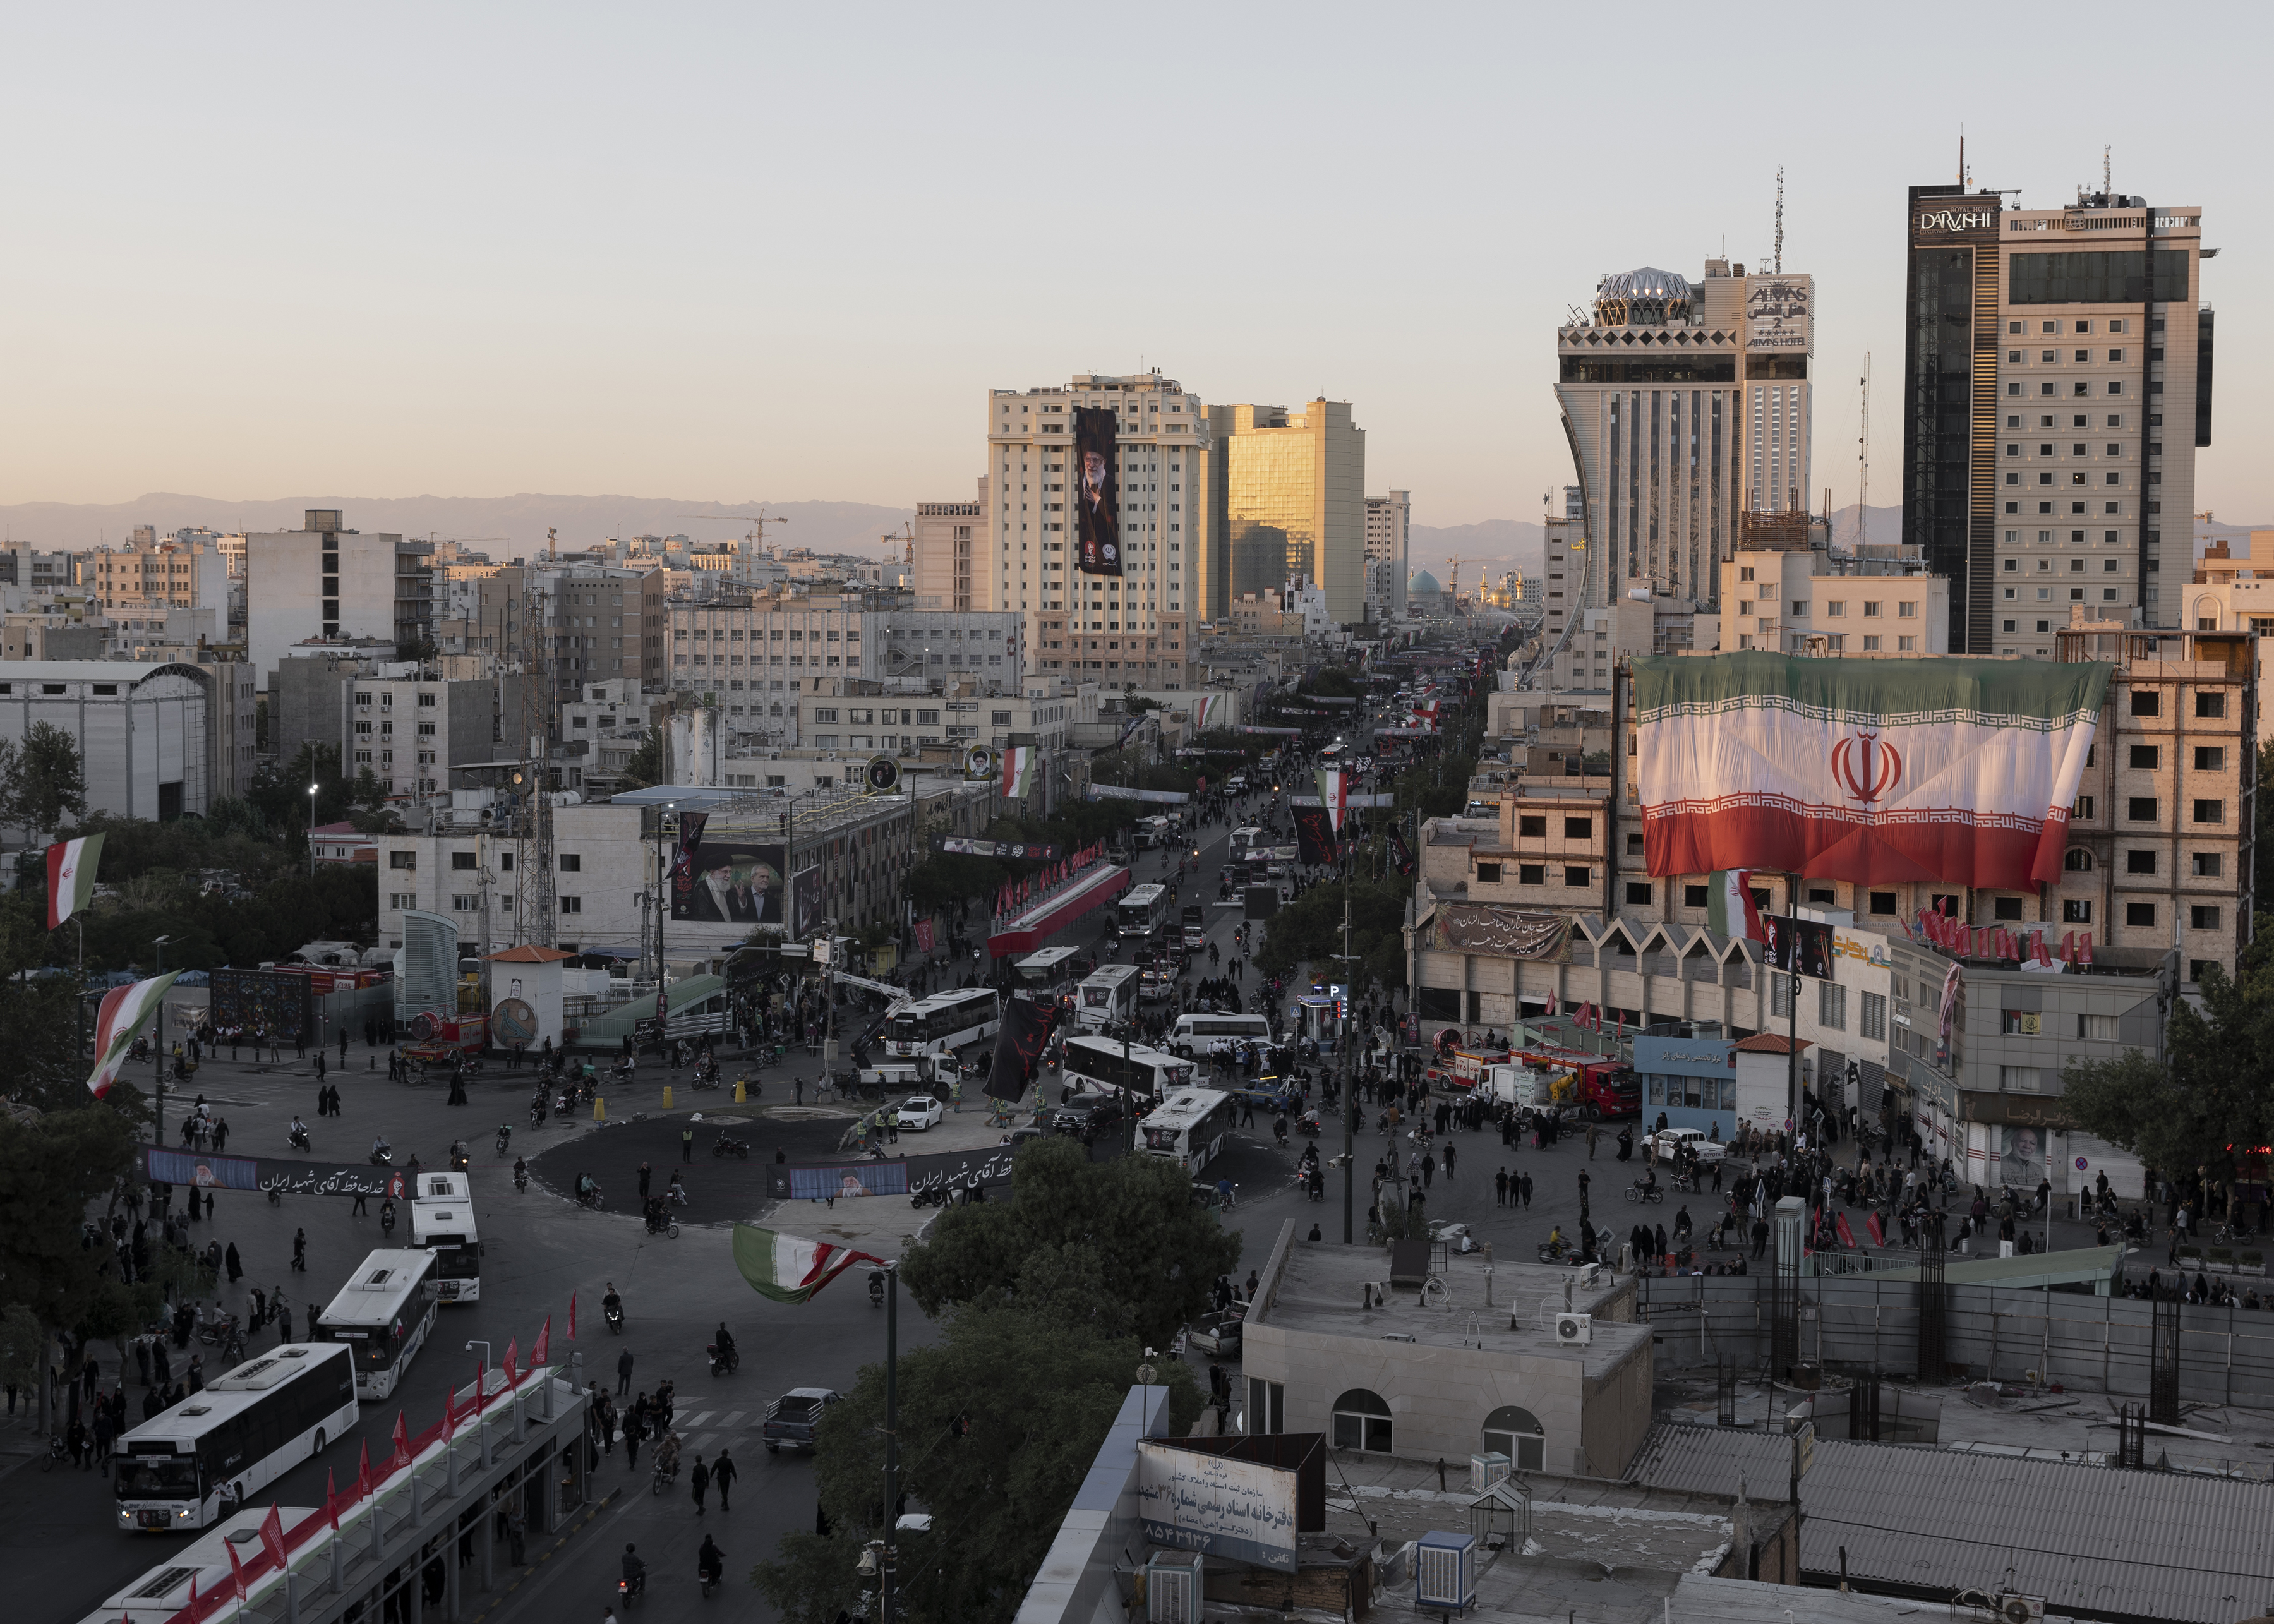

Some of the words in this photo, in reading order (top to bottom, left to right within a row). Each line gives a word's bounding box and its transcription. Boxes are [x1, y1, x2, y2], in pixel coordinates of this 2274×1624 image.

[1921, 210, 1990, 231] DARVISHI
[1747, 287, 1807, 303] ALMAS
[1747, 303, 1782, 320] الماس
[1783, 302, 1807, 319] هتل
[1774, 317, 1781, 328] 2
[1747, 338, 1779, 347] ALMAS
[1780, 337, 1805, 346] HOTEL
[1460, 913, 1481, 927] الزمان
[1480, 917, 1504, 930] صاحب
[1522, 922, 1536, 935] جان
[1467, 935, 1496, 947] زهرا
[1494, 935, 1518, 951] حضرت
[1833, 935, 1860, 954] تجارت
[1849, 946, 1870, 966] بانک
[1330, 986, 1339, 997] P
[1661, 1051, 1671, 1061] زائر
[1671, 1052, 1690, 1062] راهنمای
[1691, 1052, 1711, 1062] تخصصی
[1711, 1054, 1721, 1064] مرکز
[2006, 1107, 2042, 1125] الرضا
[2040, 1111, 2066, 1126] زائر
[944, 1161, 969, 1184] شهید
[968, 1152, 1002, 1188] آقای
[260, 1173, 291, 1192] ایران
[292, 1170, 315, 1189] شهید
[314, 1169, 349, 1195] آقای
[340, 1175, 385, 1194] خداحافظ
[910, 1169, 943, 1193] ایران
[1169, 1472, 1186, 1481] کشور
[1188, 1476, 1205, 1485] املاک
[1138, 1484, 1159, 1501] مشهد
[1157, 1484, 1172, 1502] ۳۶
[1209, 1481, 1227, 1489] اسناد
[1229, 1484, 1241, 1493] ثبت
[1241, 1488, 1263, 1497] سازمان
[1171, 1489, 1197, 1510] شماره
[1198, 1500, 1225, 1519] رسمی
[1226, 1499, 1249, 1519] اسناد
[1145, 1524, 1211, 1548] ۸۵۴۳۹۳۶
[1268, 1553, 1290, 1564] تلفن
